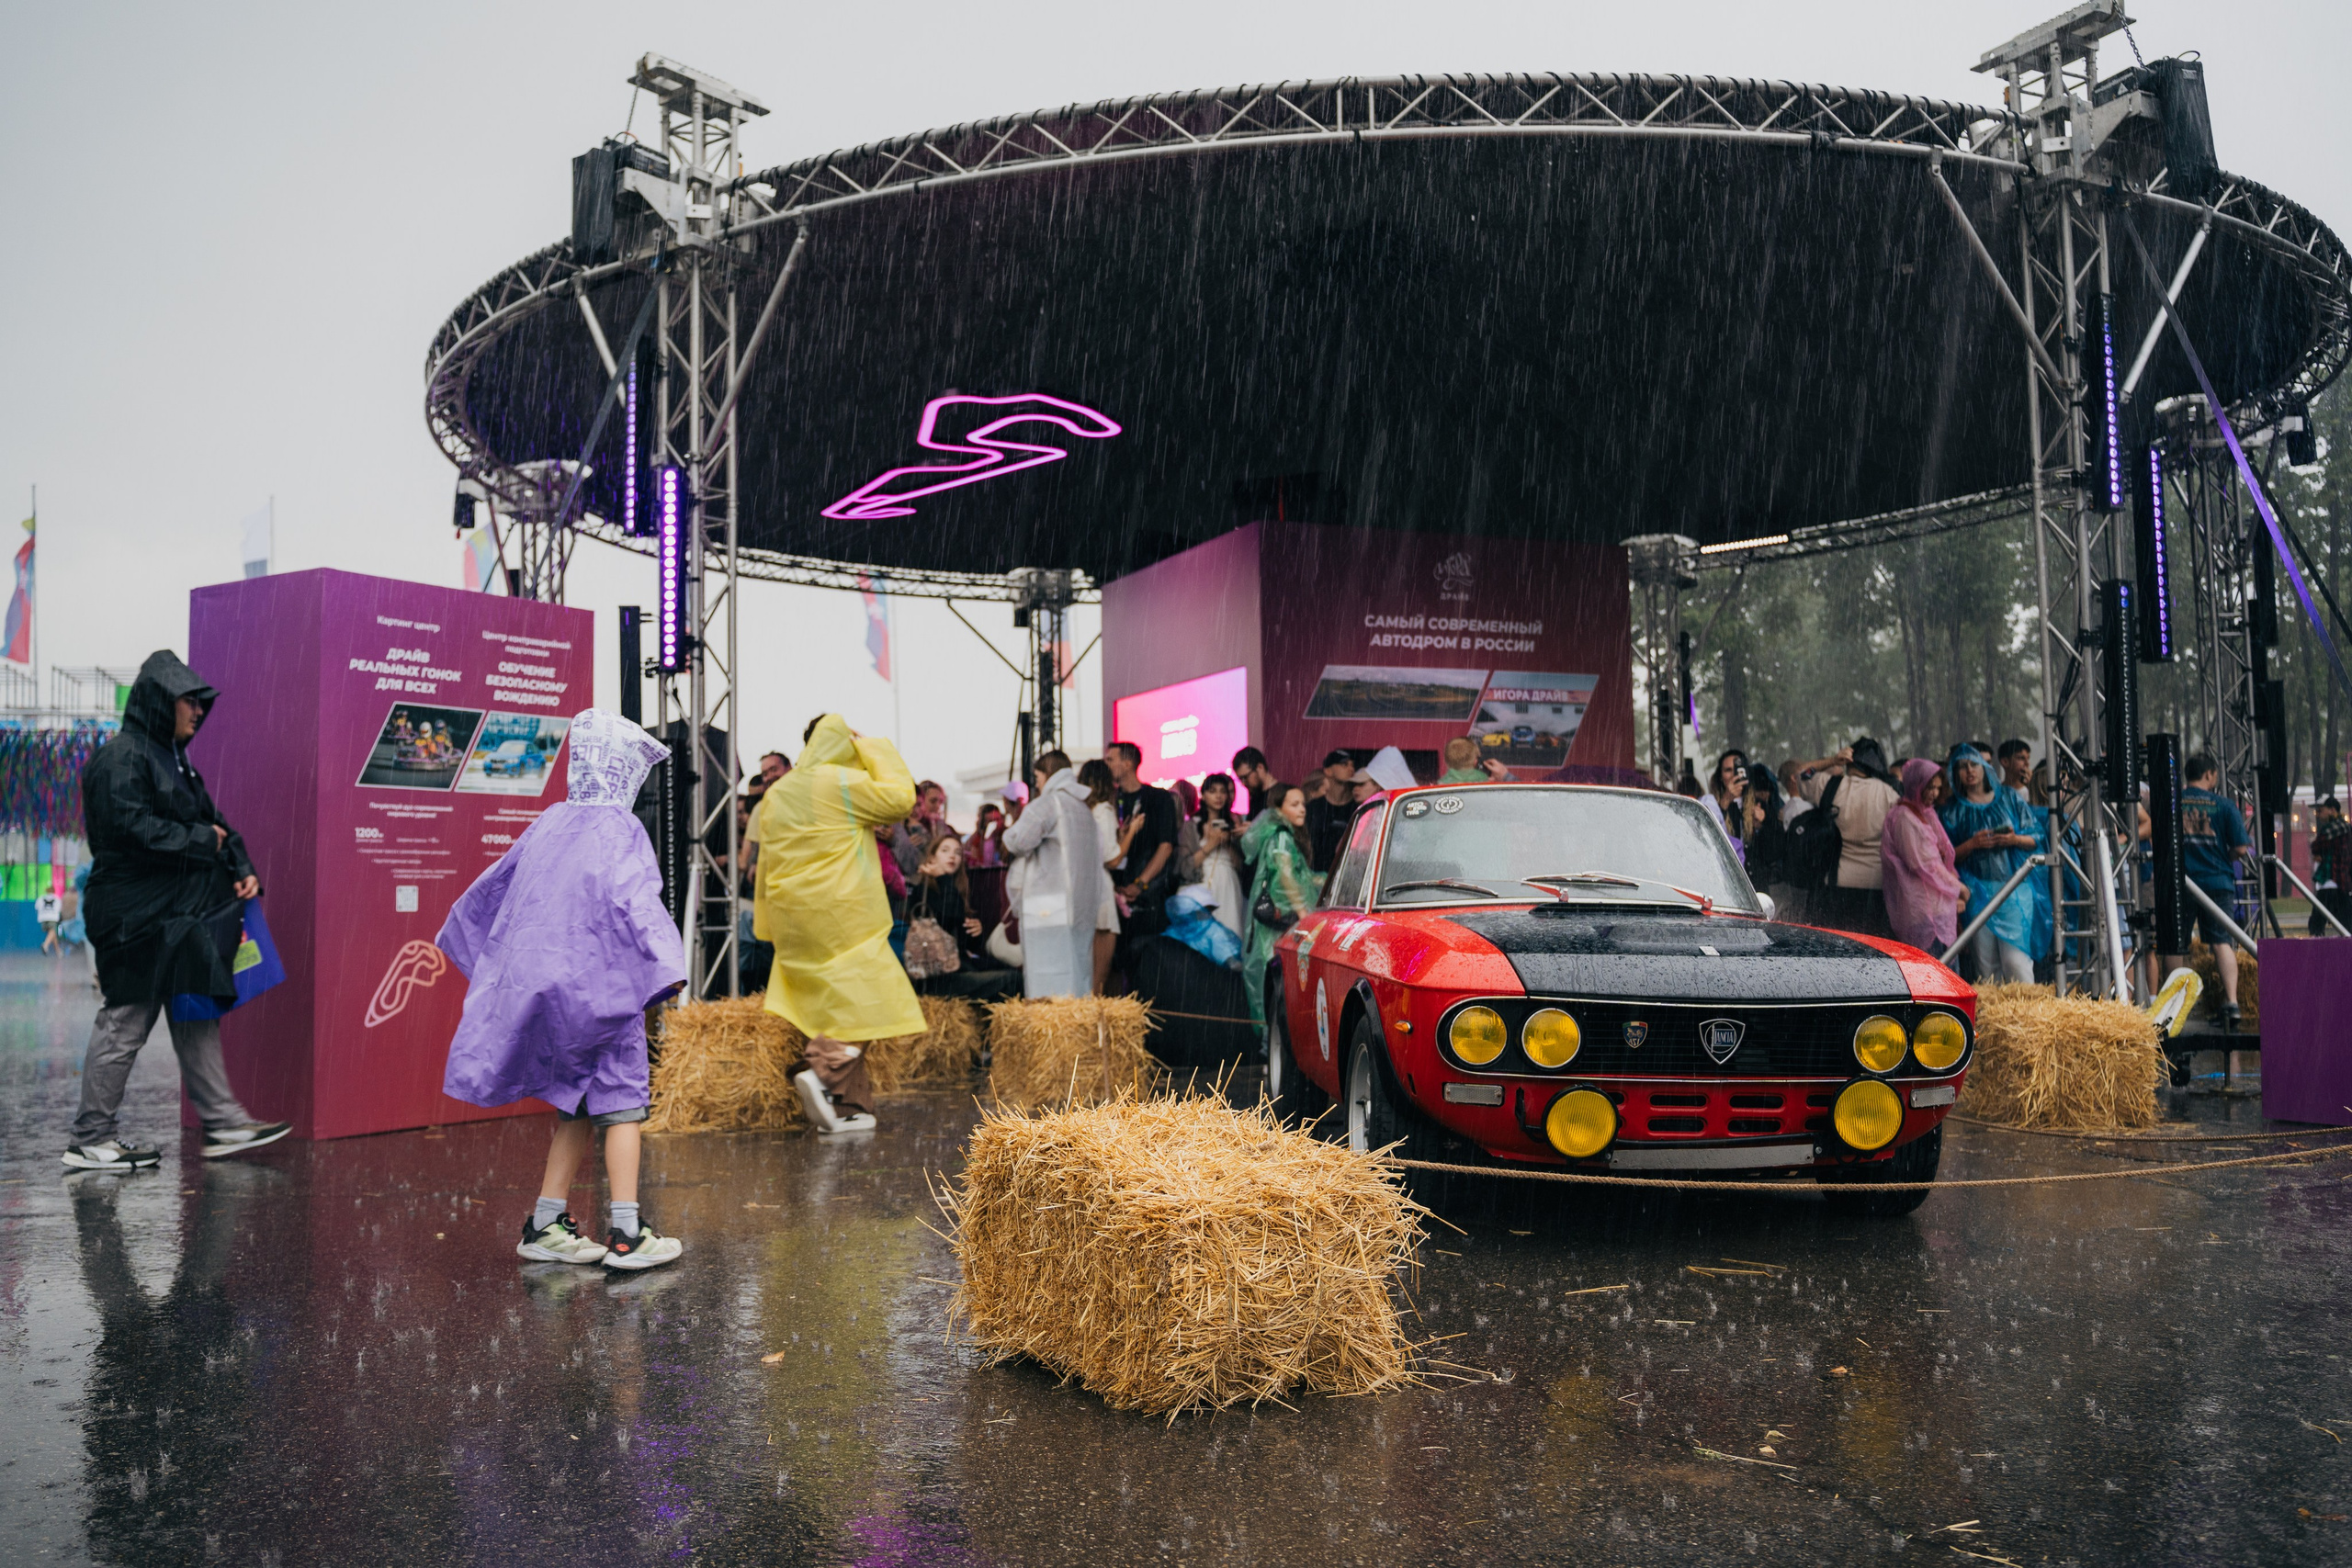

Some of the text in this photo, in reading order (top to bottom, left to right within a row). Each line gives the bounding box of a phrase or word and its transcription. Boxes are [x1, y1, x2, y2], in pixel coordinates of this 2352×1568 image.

[377, 615, 440, 633] Картинг центр
[1364, 614, 1543, 635] САМЫЙ СОВРЕМЕННЫЙ
[1369, 634, 1534, 652] АВТОДРОМ В РОССИИ
[386, 648, 430, 663] ДРАЙВ
[349, 659, 462, 682] РЕАЛЬНЫХ ГОНОК
[498, 661, 556, 679] ОБУЧЕНИЕ
[375, 677, 437, 694] ДЛЯ ВСЕХ
[485, 674, 568, 694] БЕЗОПАСНОМУ
[493, 690, 560, 707] ВОЖДЕНИЮ
[1493, 689, 1568, 703] ИГОРА ДРАЙВ
[1713, 1030, 1734, 1044] LANCIA
